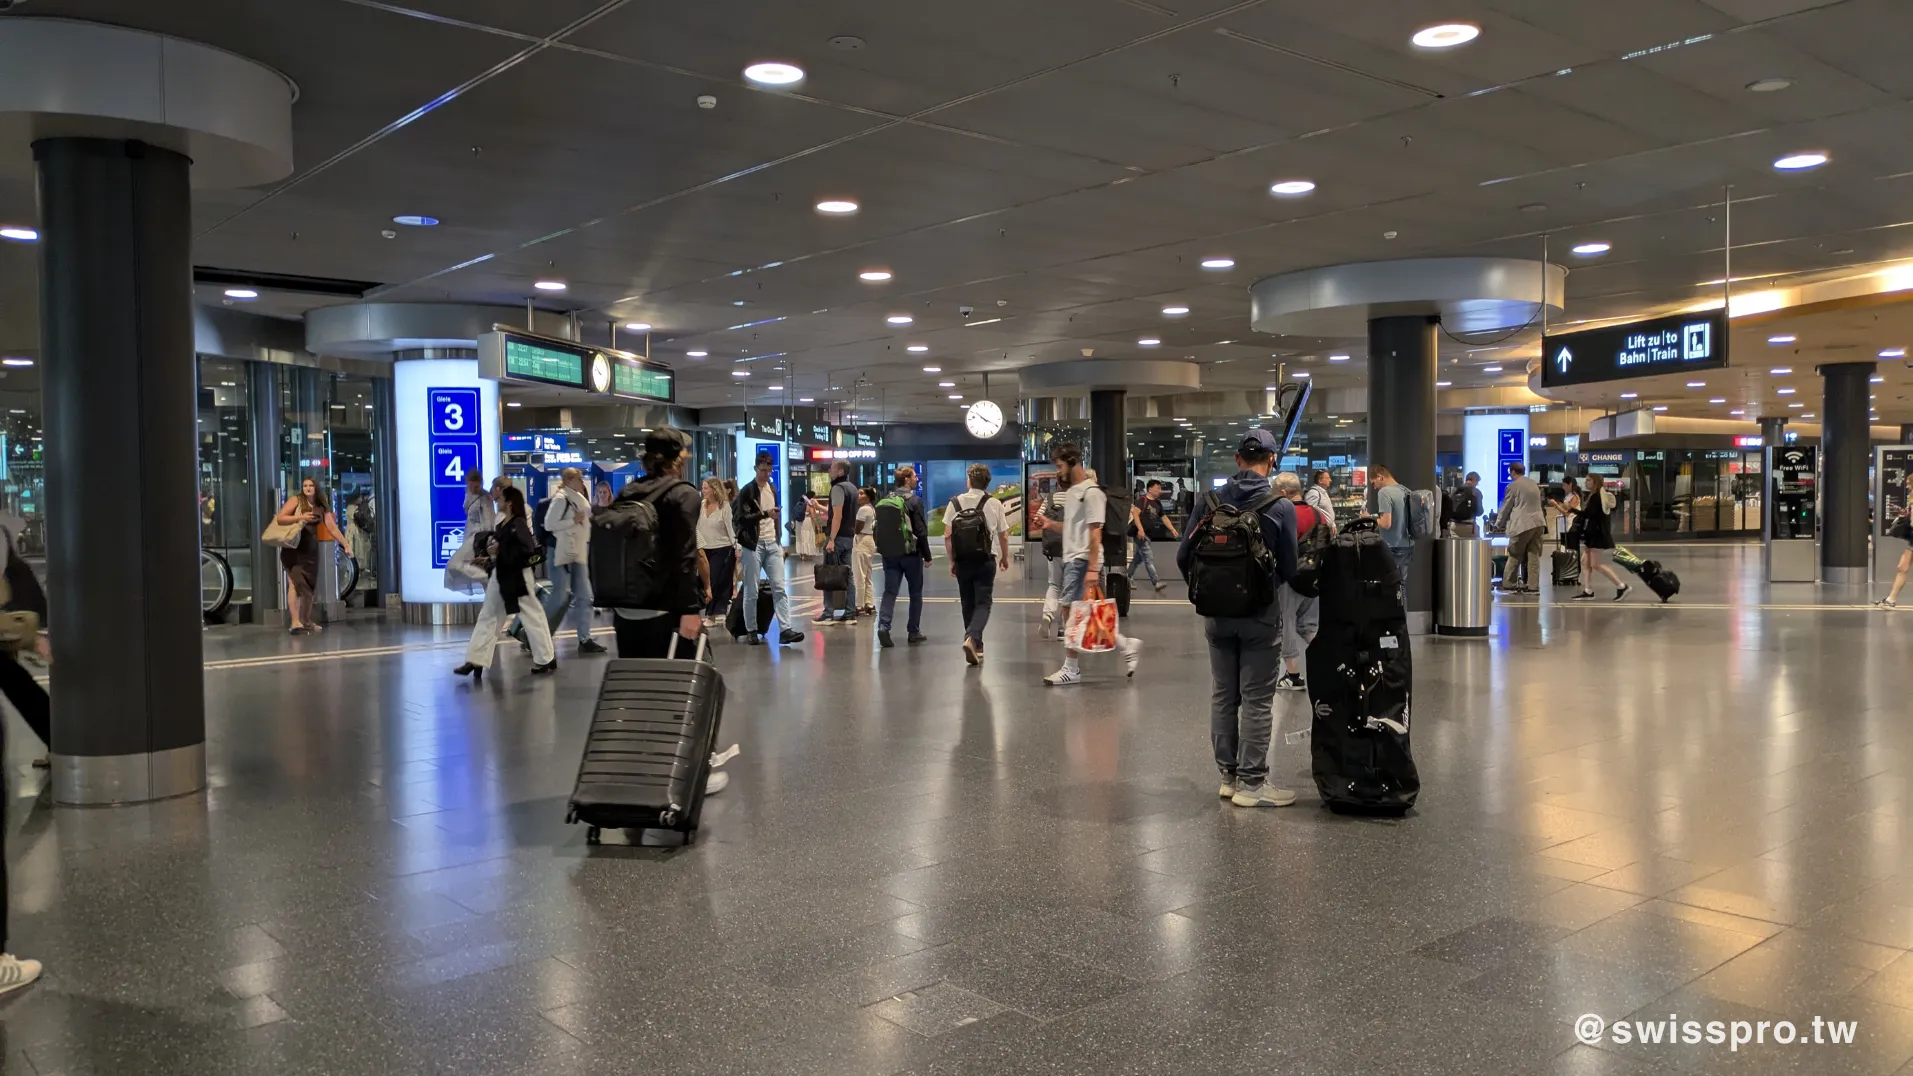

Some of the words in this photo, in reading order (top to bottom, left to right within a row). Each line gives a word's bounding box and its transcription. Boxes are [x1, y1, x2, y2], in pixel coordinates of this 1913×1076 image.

[1628, 336, 1645, 349] Lift
[1648, 337, 1660, 346] zu
[1666, 332, 1677, 343] to
[1620, 351, 1645, 364] Bahn
[1651, 348, 1677, 361] Train
[444, 403, 464, 430] 3
[1508, 437, 1515, 452] 1
[445, 456, 464, 481] 4
